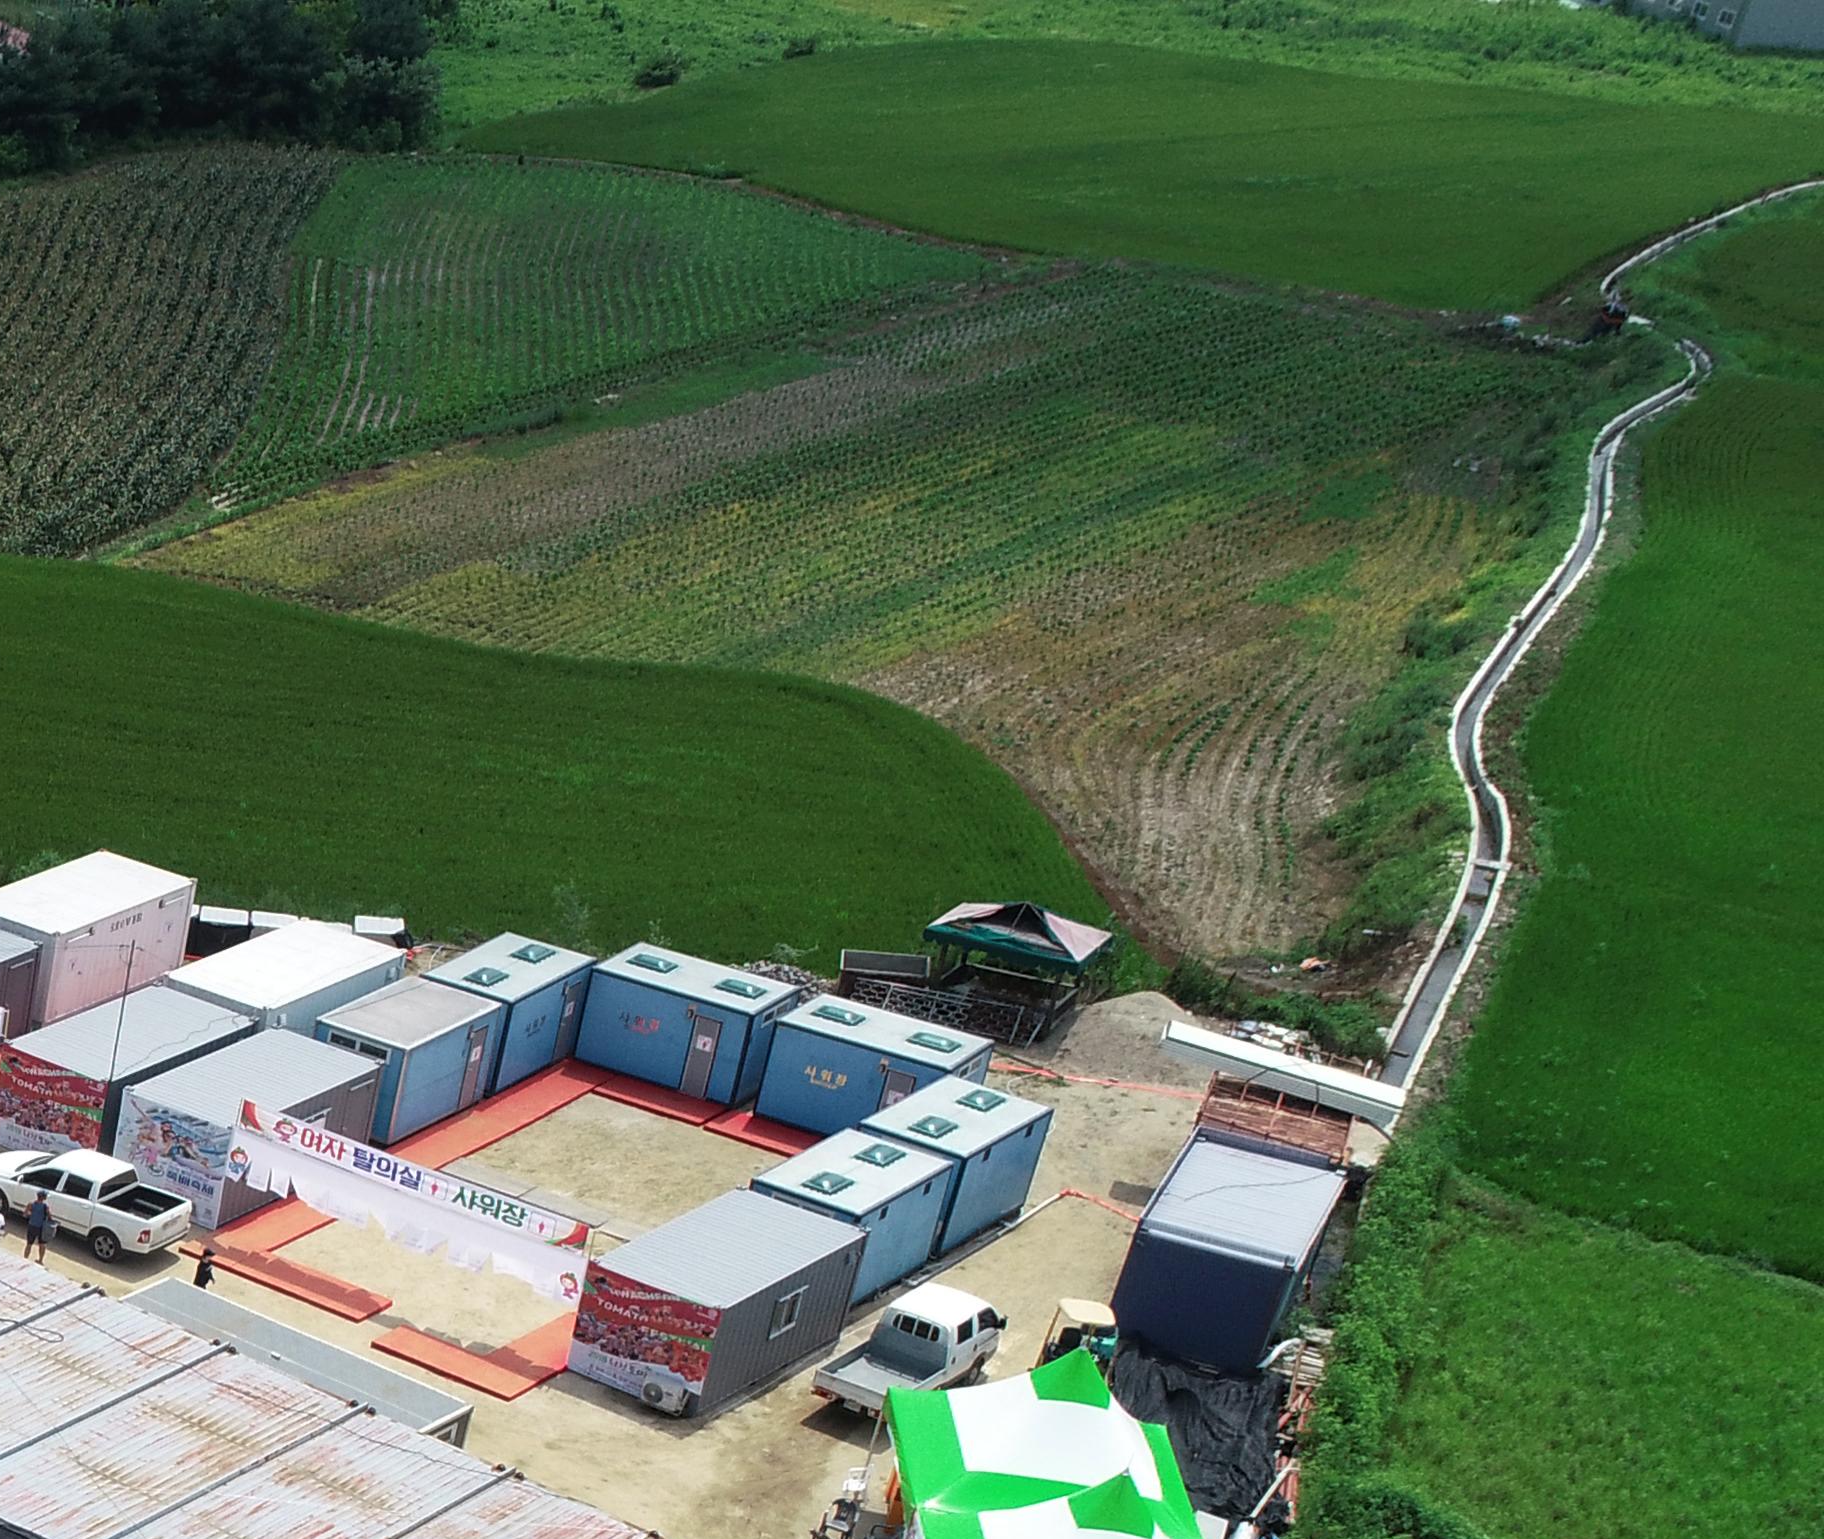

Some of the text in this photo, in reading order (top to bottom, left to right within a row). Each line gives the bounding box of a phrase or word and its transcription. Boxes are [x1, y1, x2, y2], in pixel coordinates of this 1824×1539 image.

[300, 1128, 529, 1228] 여자 탈의실 샤워장
[597, 1297, 649, 1322] TOMATO
